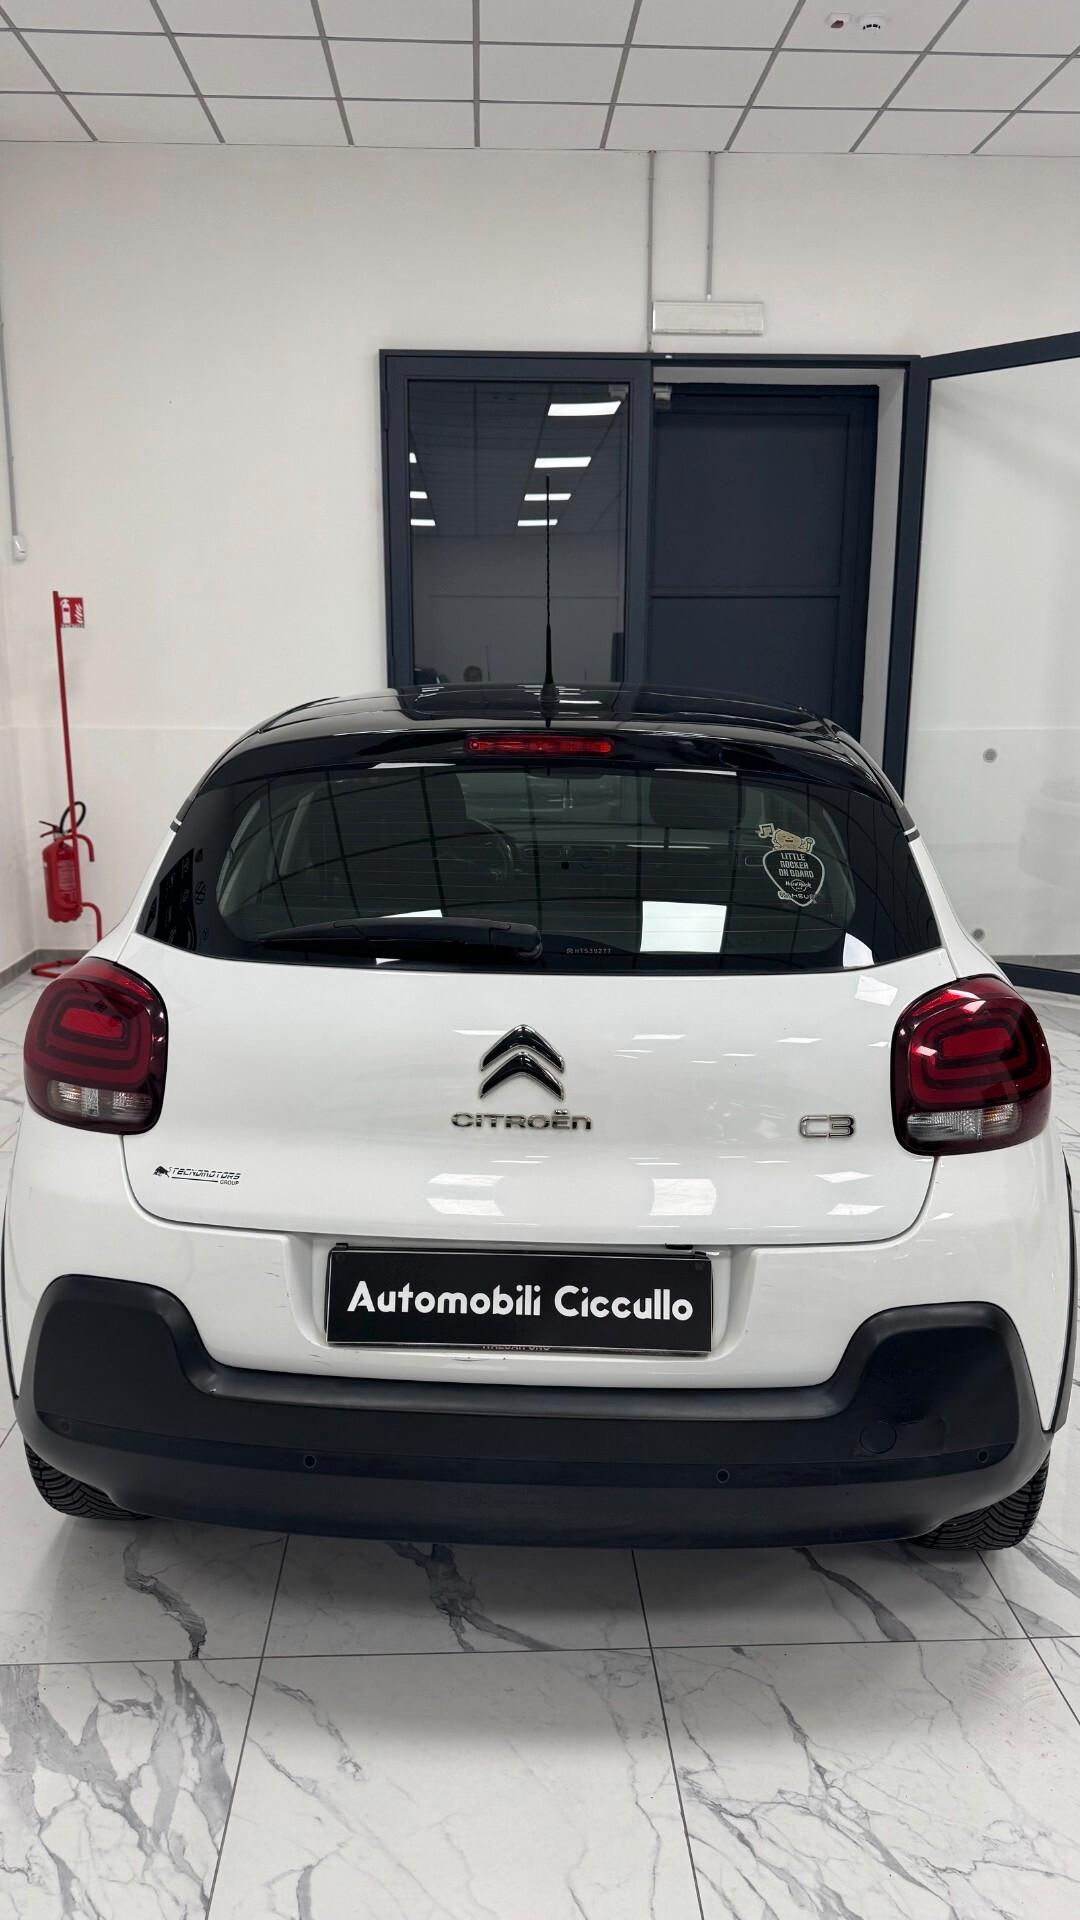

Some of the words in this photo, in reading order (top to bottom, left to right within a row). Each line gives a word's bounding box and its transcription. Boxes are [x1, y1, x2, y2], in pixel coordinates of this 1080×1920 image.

[781, 852, 806, 861] LITTLE
[780, 861, 809, 869] ROCKER
[779, 869, 789, 877] ON
[790, 869, 814, 878] BOARD
[799, 1114, 855, 1139] C3
[172, 1167, 241, 1180] TECNOMOTORS
[346, 1280, 541, 1316] Automobili
[554, 1284, 694, 1321] Ciccullo
